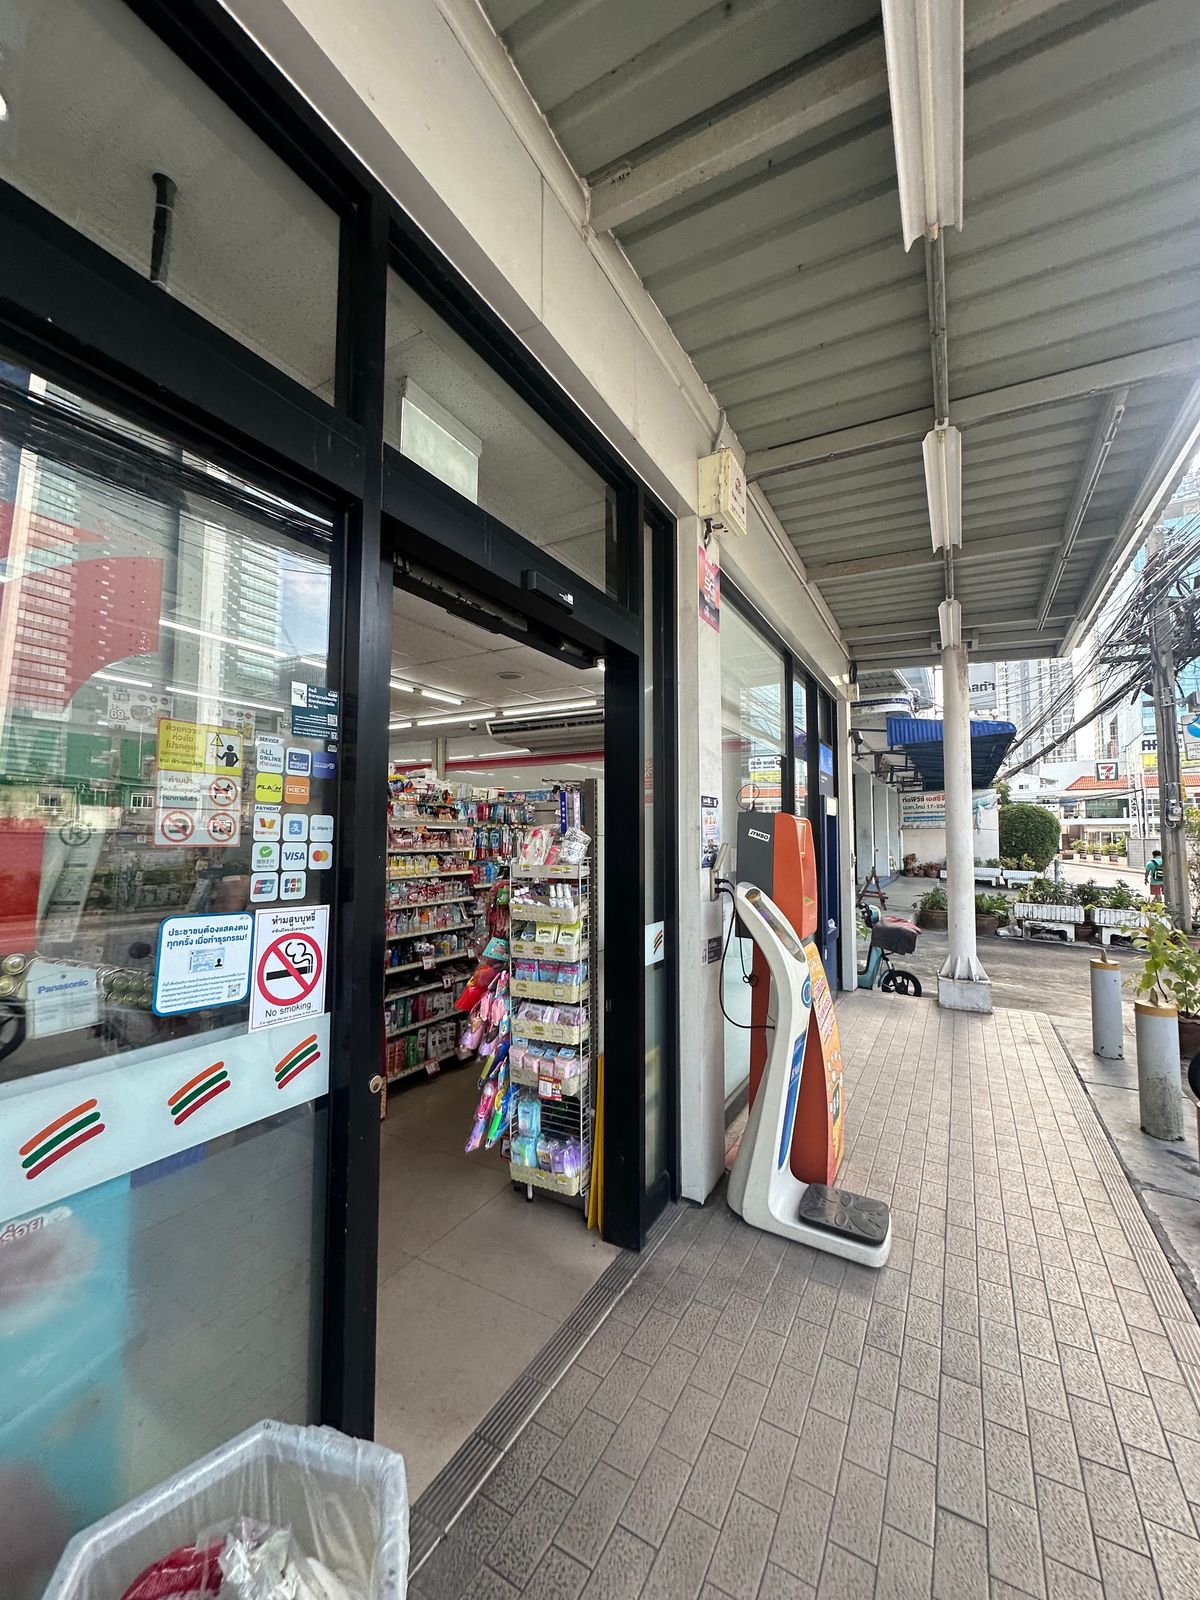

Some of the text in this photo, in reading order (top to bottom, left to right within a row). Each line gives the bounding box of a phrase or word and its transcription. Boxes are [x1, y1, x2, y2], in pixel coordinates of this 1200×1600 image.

[260, 748, 273, 756] ALL
[283, 851, 305, 861] VISA
[272, 910, 316, 926] ห้ามสูบบุหรี่
[168, 924, 249, 936] ประชาชนต้องแสดงตน
[167, 935, 194, 950] ทุกครั้ง
[37, 978, 89, 994] Panasonic
[265, 1008, 278, 1018] No
